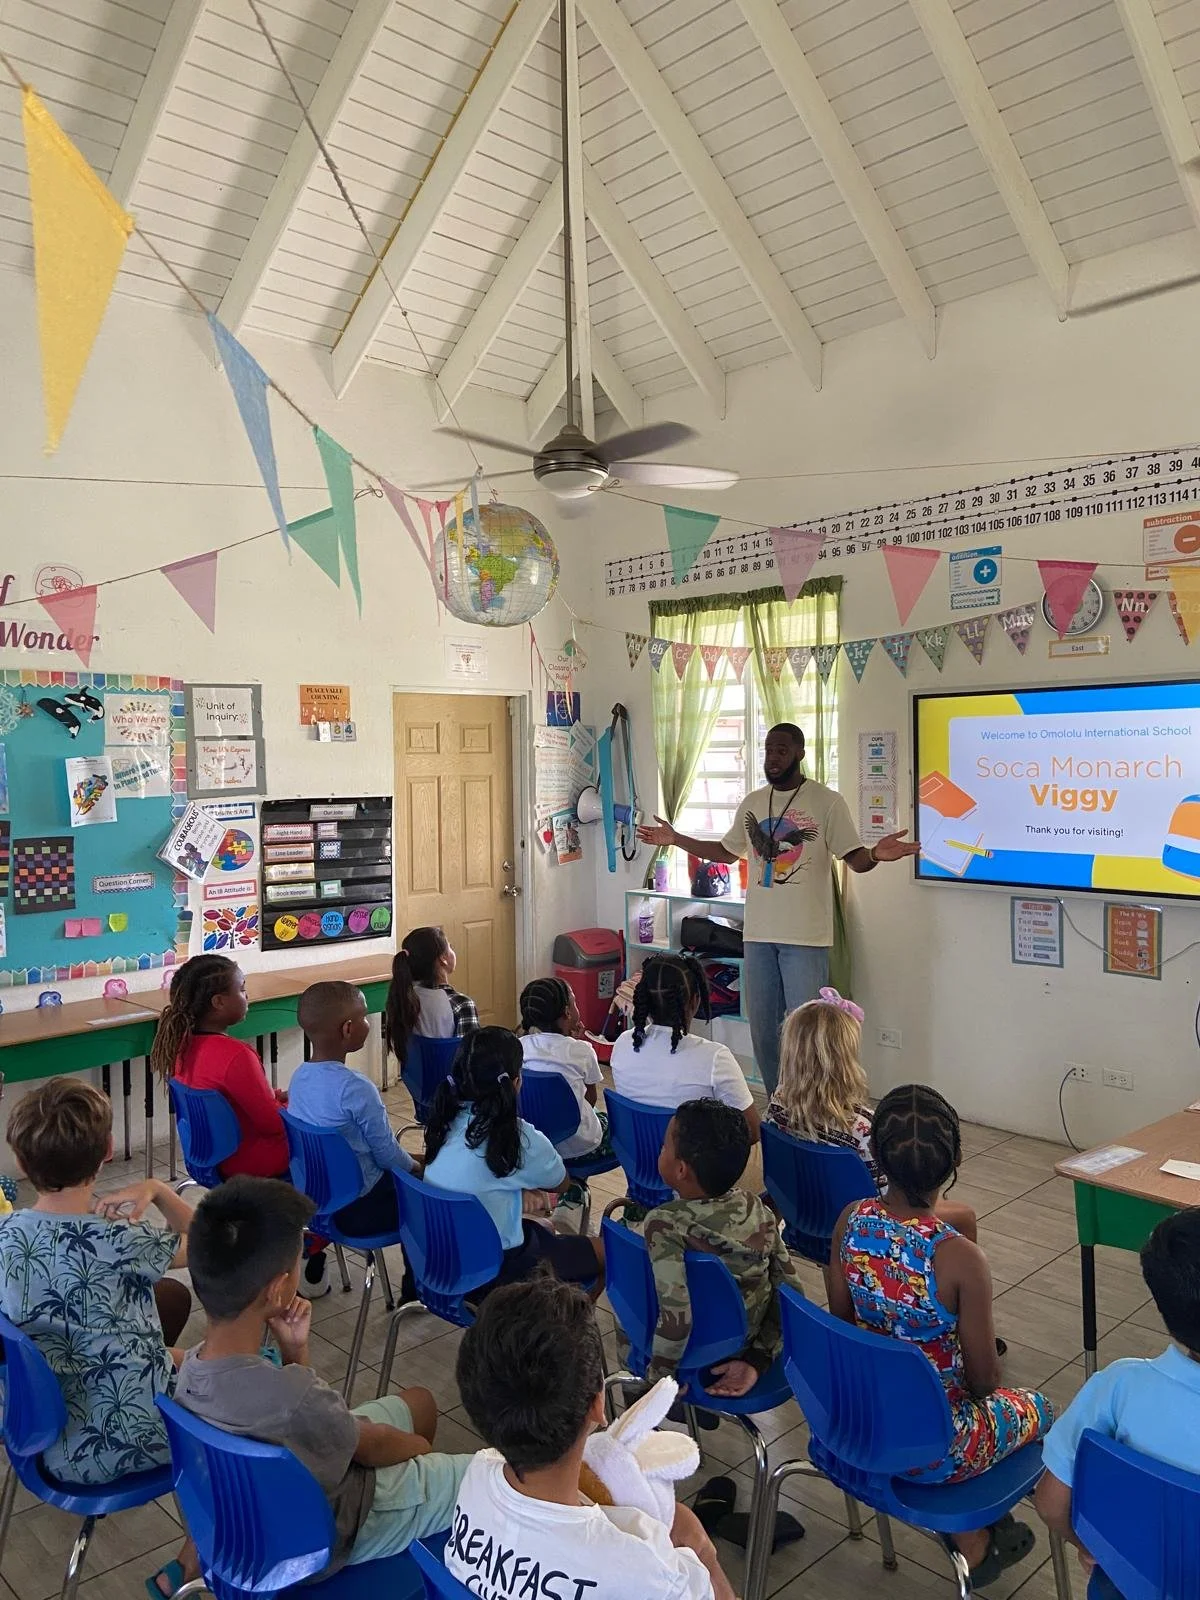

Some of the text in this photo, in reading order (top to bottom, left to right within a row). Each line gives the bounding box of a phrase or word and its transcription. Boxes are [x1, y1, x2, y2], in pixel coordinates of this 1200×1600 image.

[703, 550, 710, 560] 10
[714, 547, 722, 557] 11
[726, 545, 734, 554] 12
[740, 542, 748, 551] 13
[752, 540, 760, 549] 14
[765, 537, 773, 546] 15
[832, 523, 840, 533] 20
[846, 521, 854, 530] 21
[861, 518, 869, 527] 22
[874, 515, 883, 525] 23
[890, 512, 899, 522] 24
[907, 509, 916, 519] 25
[922, 506, 932, 516] 26
[939, 502, 948, 513] 27
[955, 500, 965, 510] 28
[972, 496, 982, 507] 29
[990, 492, 1000, 503] 30
[1007, 489, 1017, 500] 31
[1026, 485, 1036, 497] 32
[1044, 482, 1055, 493] 33
[1064, 478, 1075, 490] 34
[1083, 474, 1095, 486] 35
[1103, 470, 1115, 483] 36
[1126, 466, 1138, 479] 37
[1147, 463, 1160, 475] 38
[1169, 459, 1183, 471] 39
[1146, 514, 1193, 527] subtraction
[619, 586, 625, 594] 77
[729, 566, 737, 575] 87
[741, 563, 749, 573] 88
[753, 561, 761, 571] 89
[766, 559, 774, 569] 90
[832, 546, 841, 557] 95
[846, 544, 855, 554] 96
[861, 541, 871, 551] 97
[893, 535, 902, 546] 99
[906, 532, 920, 544] 100
[921, 530, 935, 541] 101
[938, 527, 953, 539] 102
[954, 524, 969, 536] 103
[971, 522, 986, 533] 104
[989, 519, 1005, 530] 105
[1006, 516, 1022, 528] 106
[1025, 512, 1041, 525] 107
[1044, 509, 1061, 522] 108
[1066, 506, 1083, 519] 109
[1085, 503, 1103, 516] 110
[1106, 499, 1123, 513] 111
[1127, 496, 1145, 509] 112
[1148, 492, 1166, 506] 113
[1169, 489, 1189, 502] 114
[925, 633, 944, 649] Kk
[651, 643, 664, 655] Bb
[227, 702, 235, 710] of
[112, 715, 166, 724] Who We Are
[345, 724, 352, 734] 4
[981, 726, 1192, 741] Welcome to Omololu International School
[976, 754, 1183, 779] Soca Monarch
[1029, 783, 1119, 812] Viggy
[174, 809, 200, 851] COURAGEOUS
[1025, 825, 1124, 837] Thank you for visiting!
[224, 885, 245, 893] Attitude
